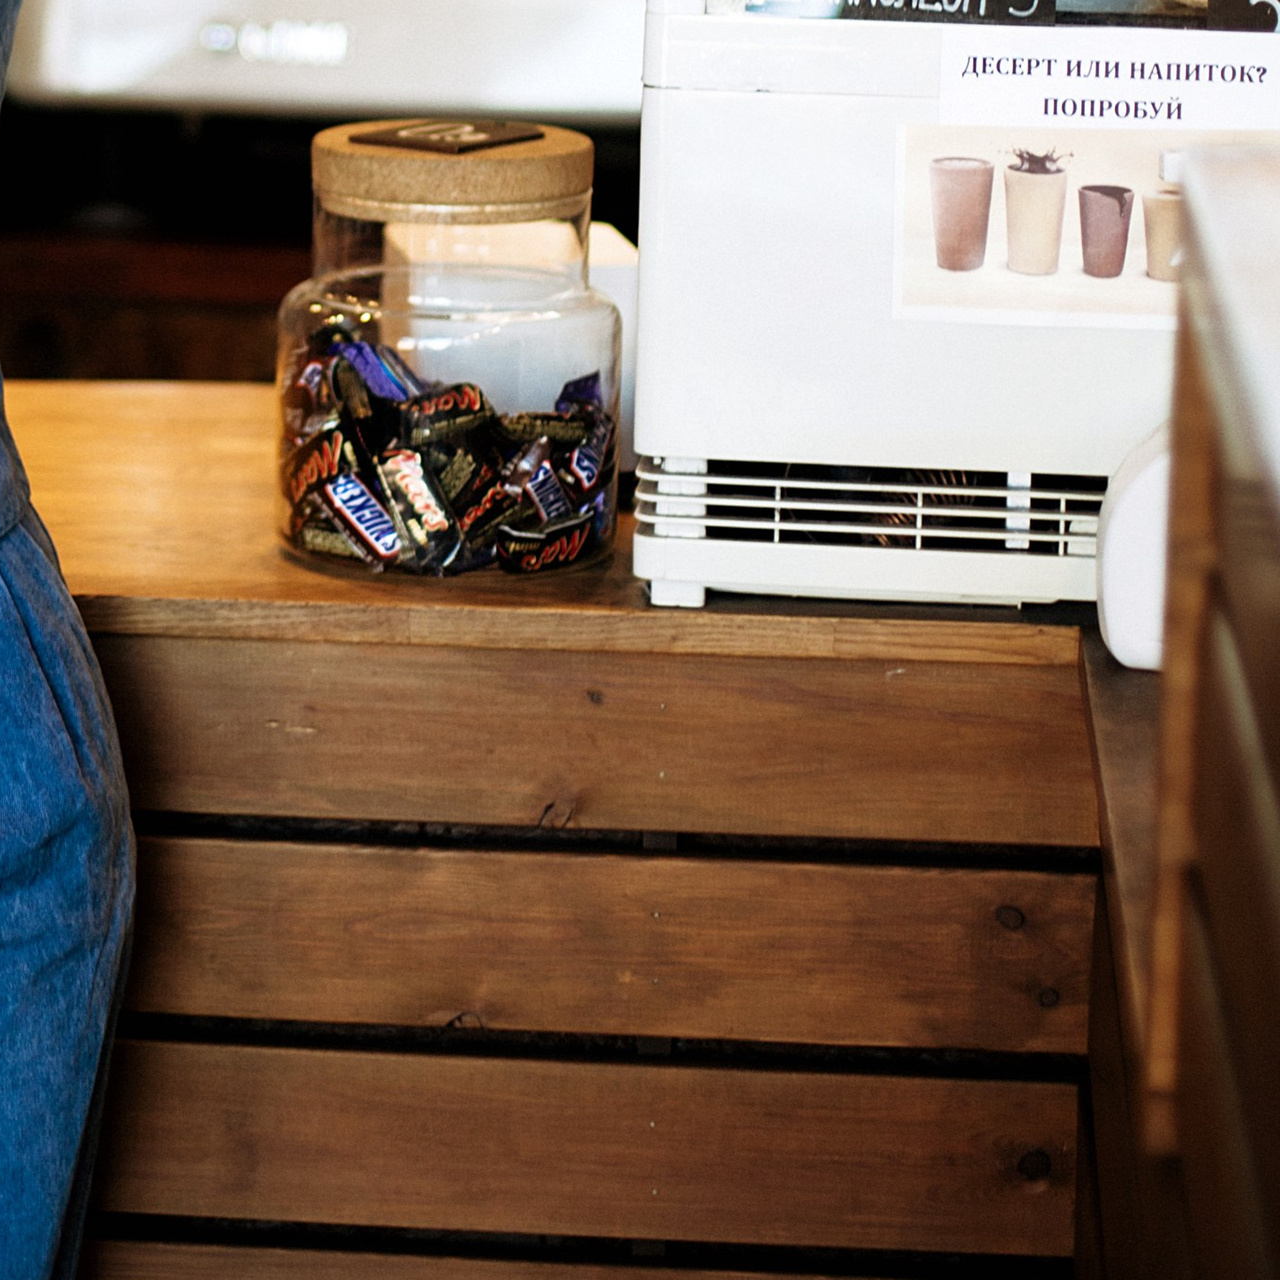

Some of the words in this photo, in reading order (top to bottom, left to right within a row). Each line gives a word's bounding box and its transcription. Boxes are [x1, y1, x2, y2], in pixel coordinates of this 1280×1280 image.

[962, 55, 1057, 78] ДЕСЕРТ
[1065, 59, 1120, 79] ИЛИ
[1130, 61, 1268, 84] НАПИТОК?
[1043, 95, 1183, 120] ПОПРОБУЙ
